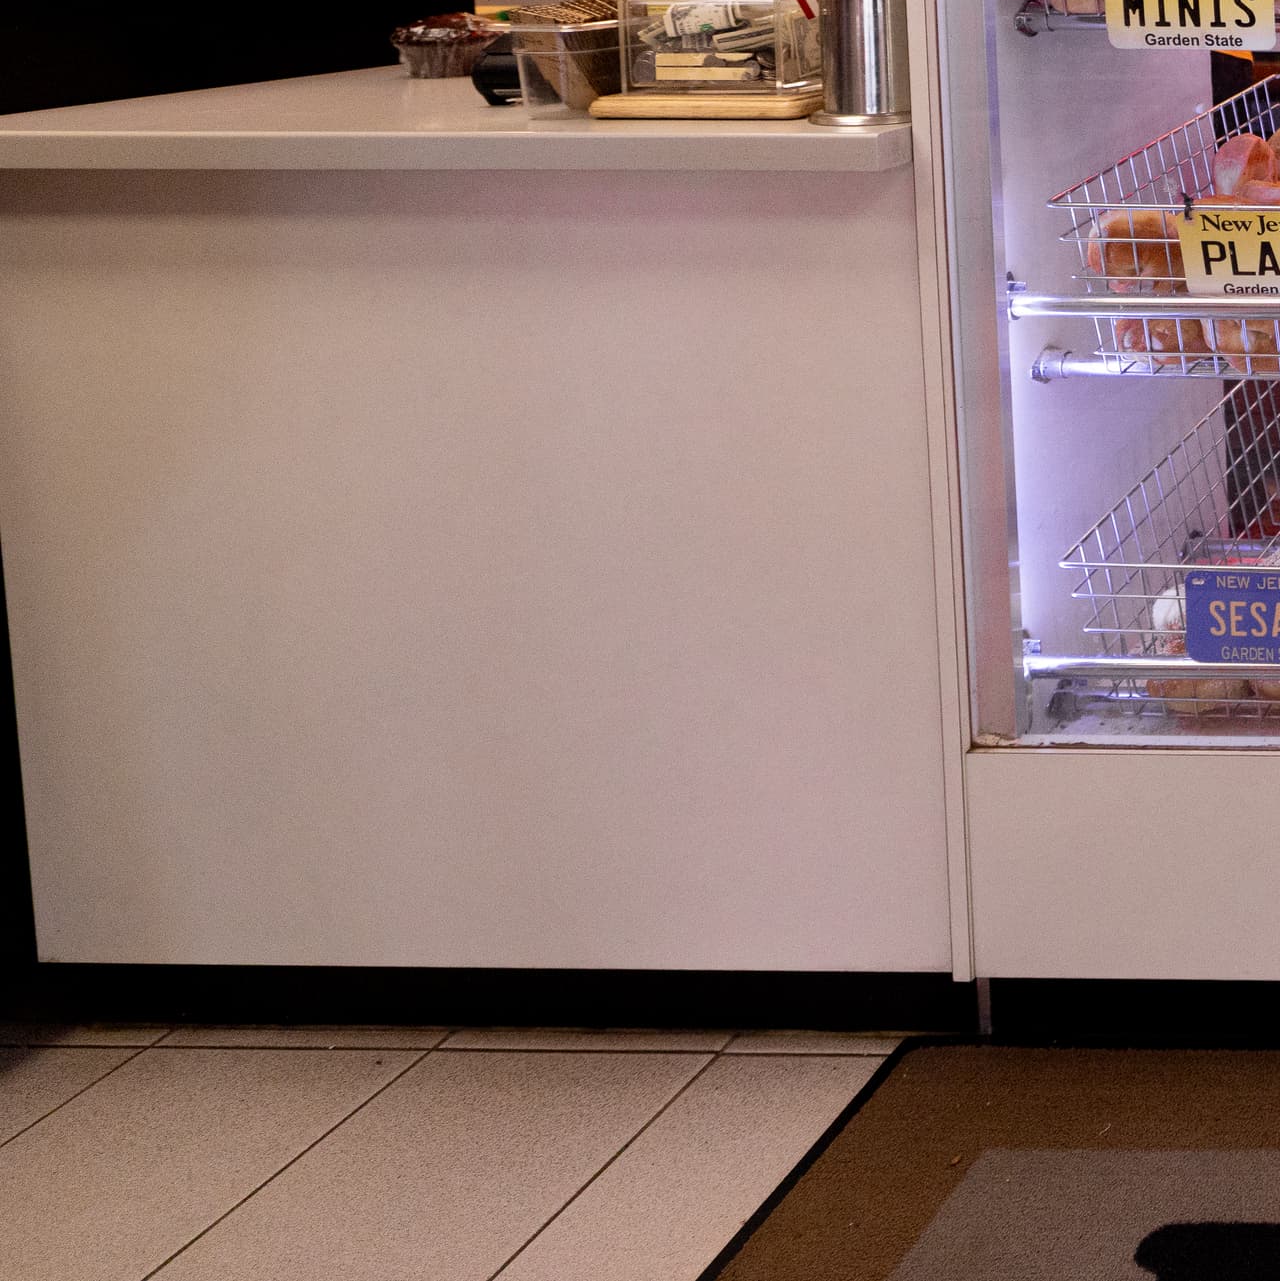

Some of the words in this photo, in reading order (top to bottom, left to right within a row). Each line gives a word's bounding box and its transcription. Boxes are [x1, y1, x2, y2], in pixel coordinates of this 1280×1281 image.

[1144, 32, 1201, 47] Garden
[1204, 32, 1243, 47] State
[1201, 212, 1252, 231] New
